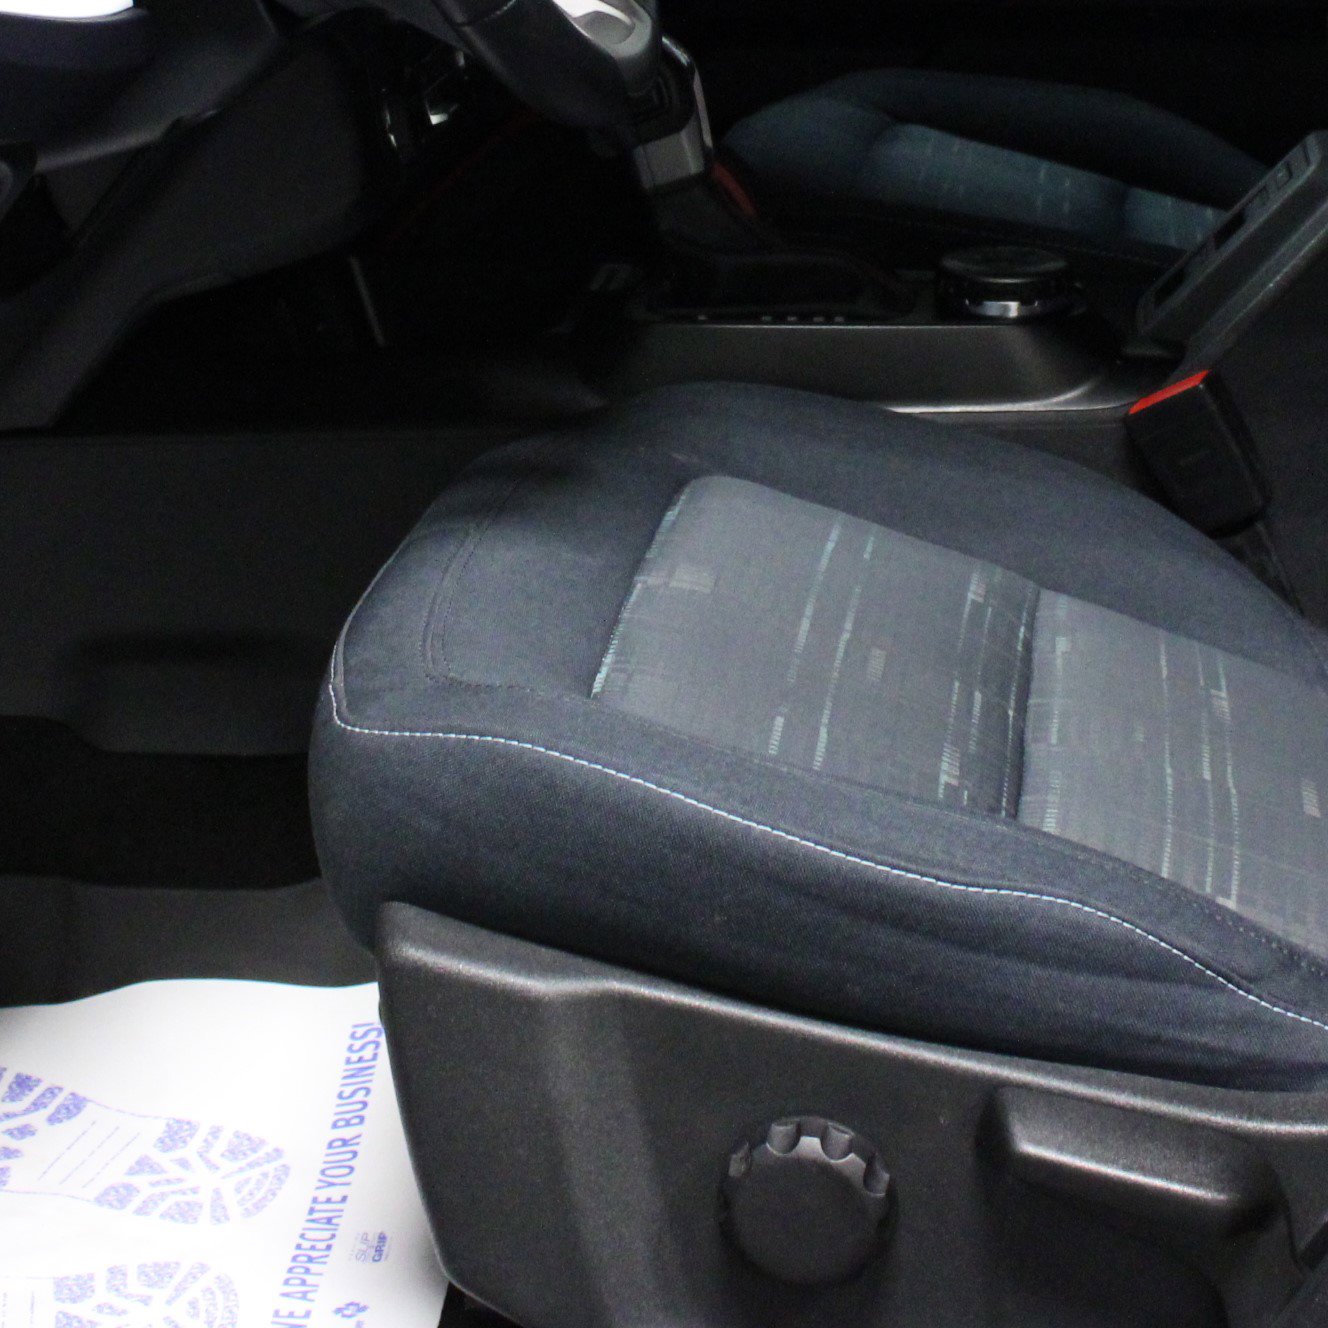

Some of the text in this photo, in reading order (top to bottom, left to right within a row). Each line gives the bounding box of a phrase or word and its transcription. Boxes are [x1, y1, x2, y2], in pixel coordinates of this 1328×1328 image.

[279, 1194, 349, 1303] APPRECIATE
[314, 1133, 363, 1191] YOUR
[372, 1231, 388, 1263] GRIP
